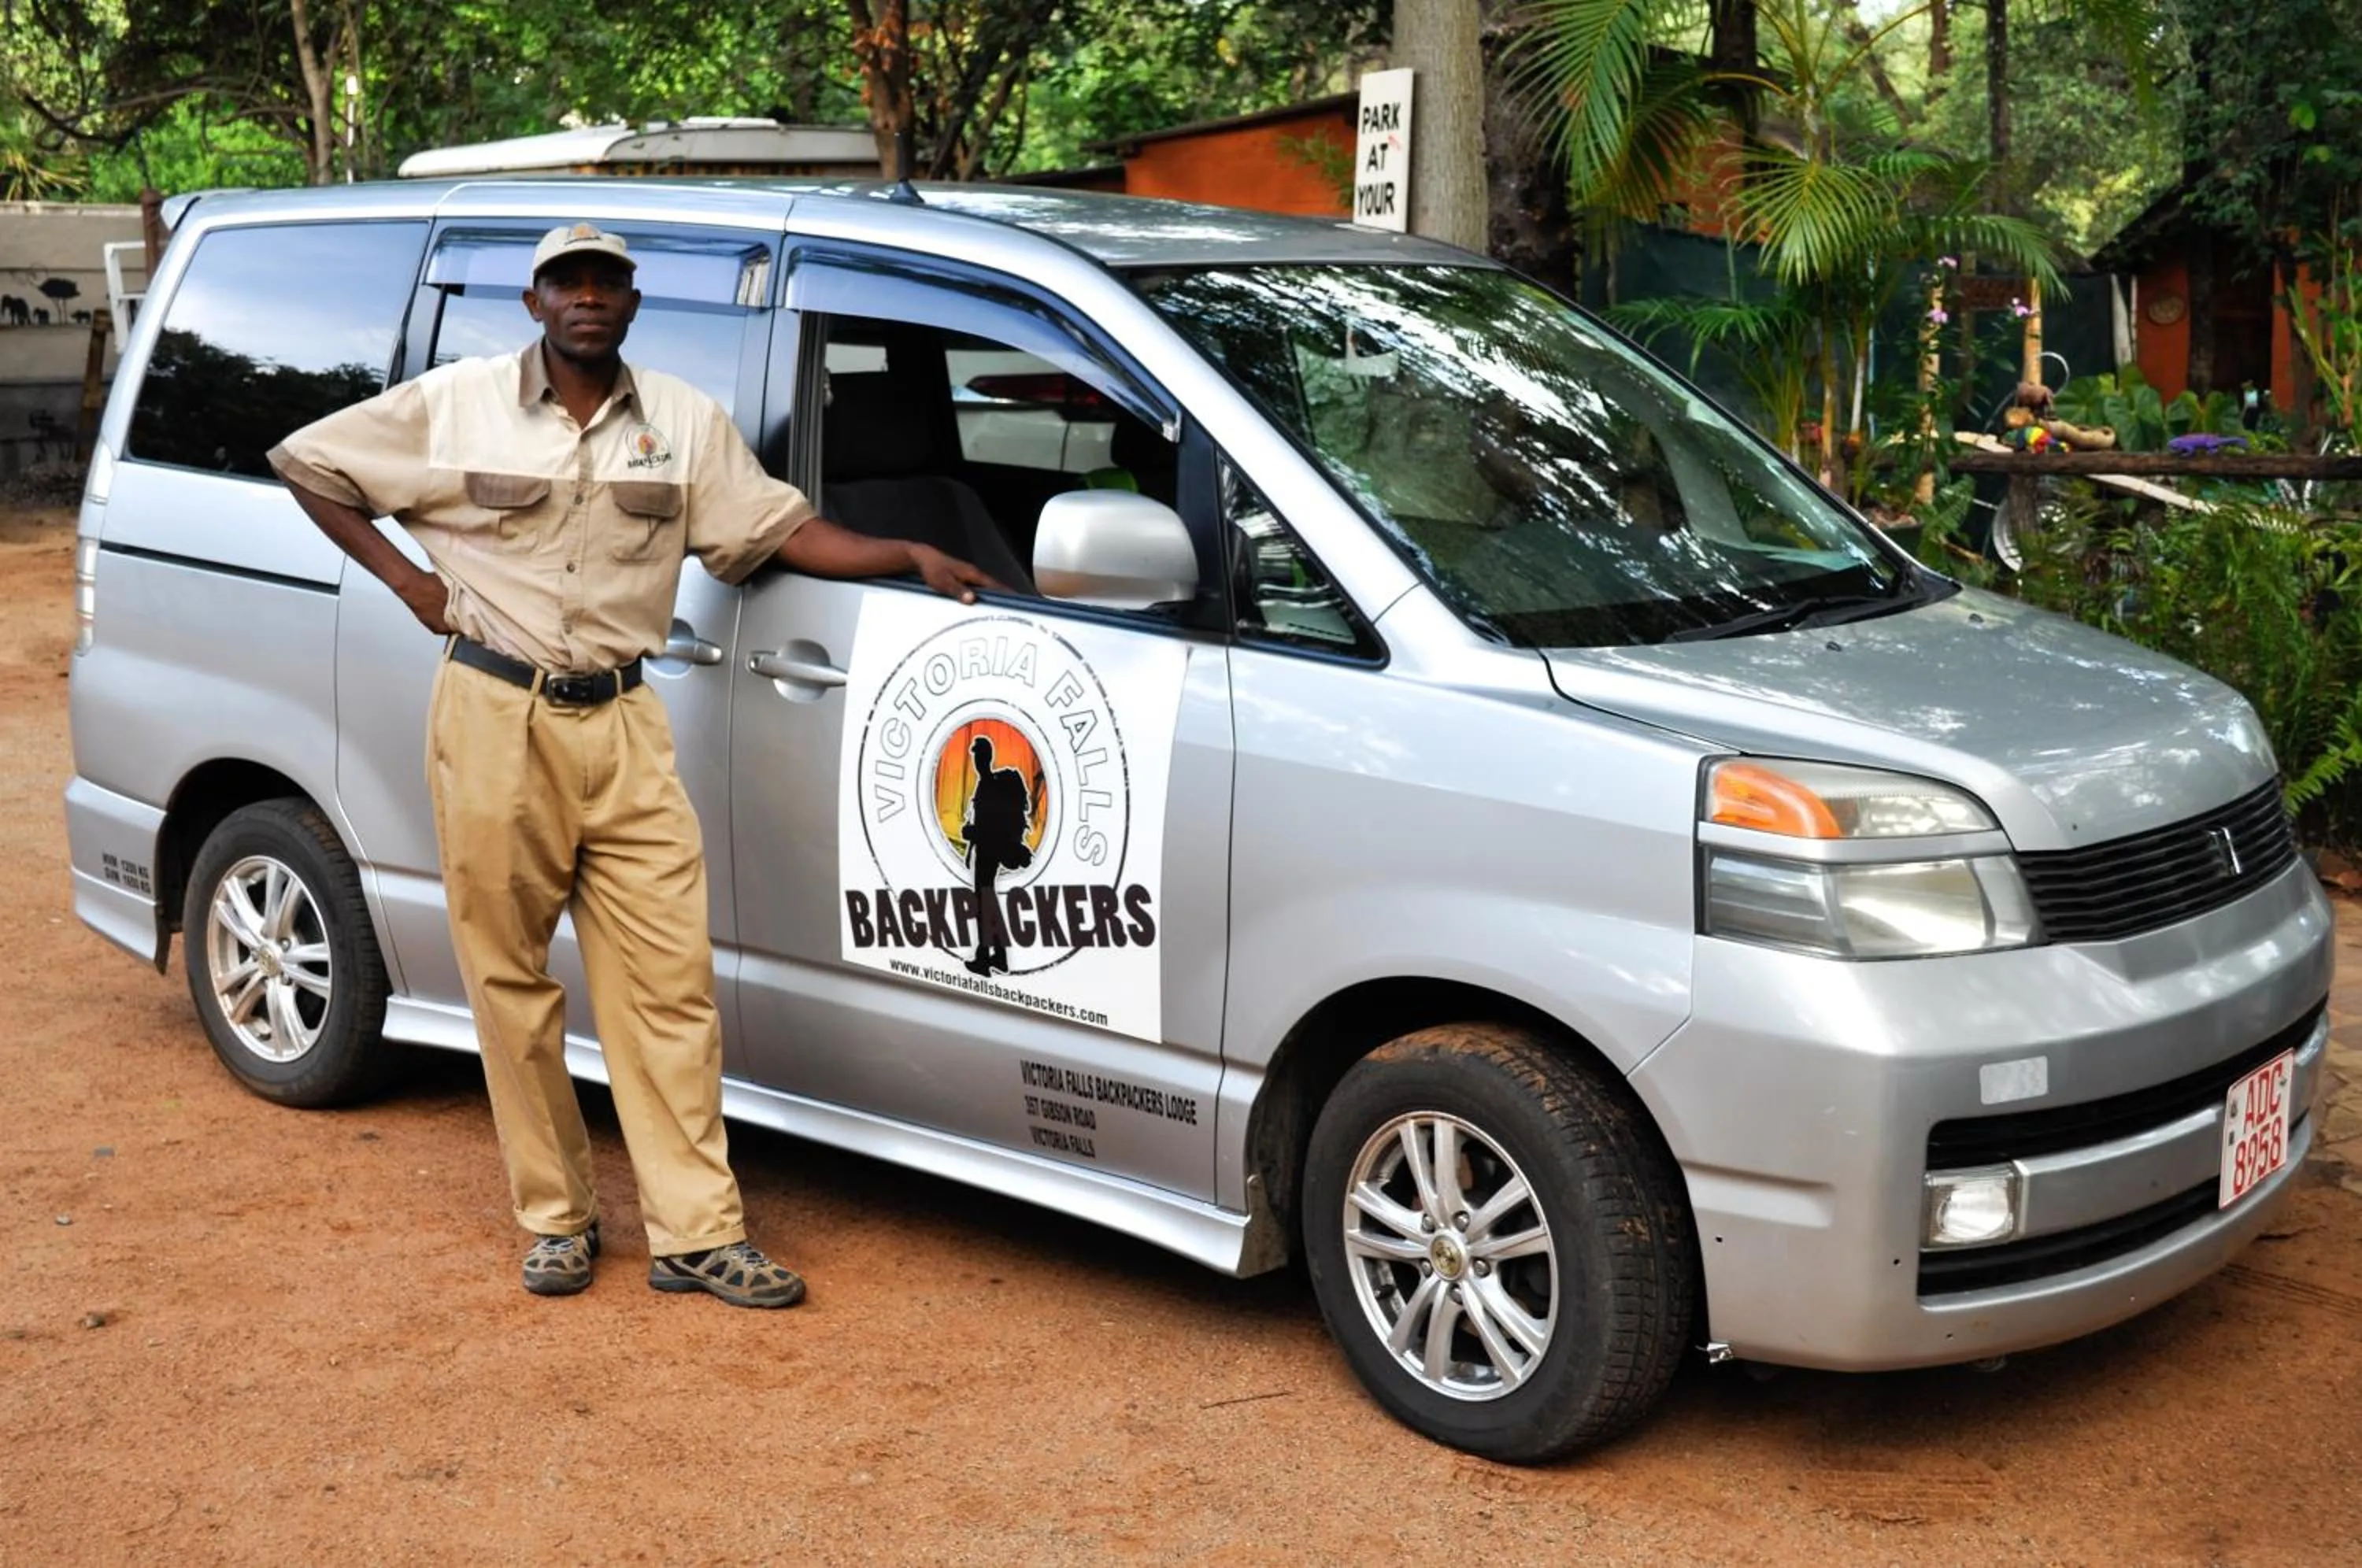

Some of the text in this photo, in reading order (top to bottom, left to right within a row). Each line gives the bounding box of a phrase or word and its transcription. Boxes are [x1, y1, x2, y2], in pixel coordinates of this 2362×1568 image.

[1362, 102, 1401, 135] PARK
[1366, 142, 1389, 172] AT
[1358, 182, 1394, 216] YOUR
[871, 637, 1112, 867] VICTORIA FALLS
[845, 883, 1157, 949] BACKPACKERS
[889, 958, 1109, 1026] www.victoriafallsbackpackers.com
[1020, 1060, 1198, 1126] VICTORIA FALLS BACKPACKERS LODGE
[2244, 1061, 2283, 1134] ADC
[2234, 1115, 2282, 1195] 8958
